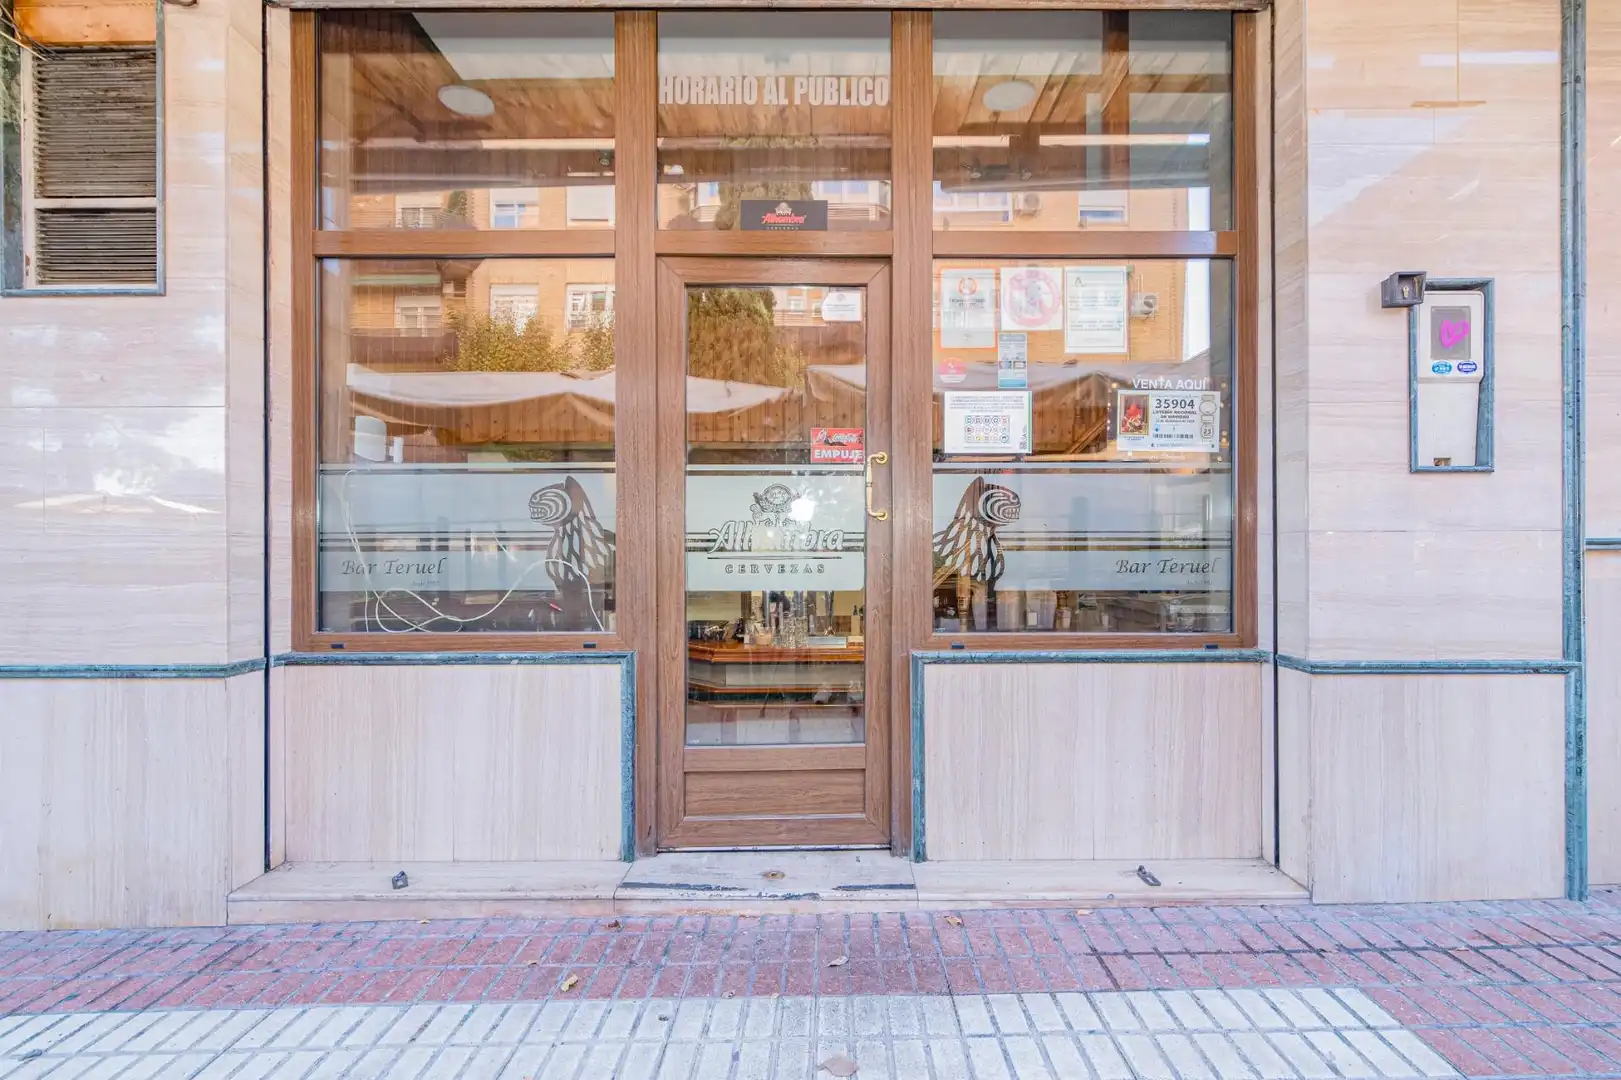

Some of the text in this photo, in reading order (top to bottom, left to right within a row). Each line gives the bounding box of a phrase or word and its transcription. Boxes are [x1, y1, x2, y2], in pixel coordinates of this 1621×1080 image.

[658, 75, 758, 105] HORARIO
[763, 76, 788, 105] AL
[1132, 379, 1172, 389] VENTA
[1155, 398, 1195, 409] 35904
[814, 449, 863, 459] EMPUJE
[342, 557, 448, 575] Bar Teruel
[725, 564, 825, 574] CERVEZAS
[1116, 557, 1222, 574] Bar Teruel
